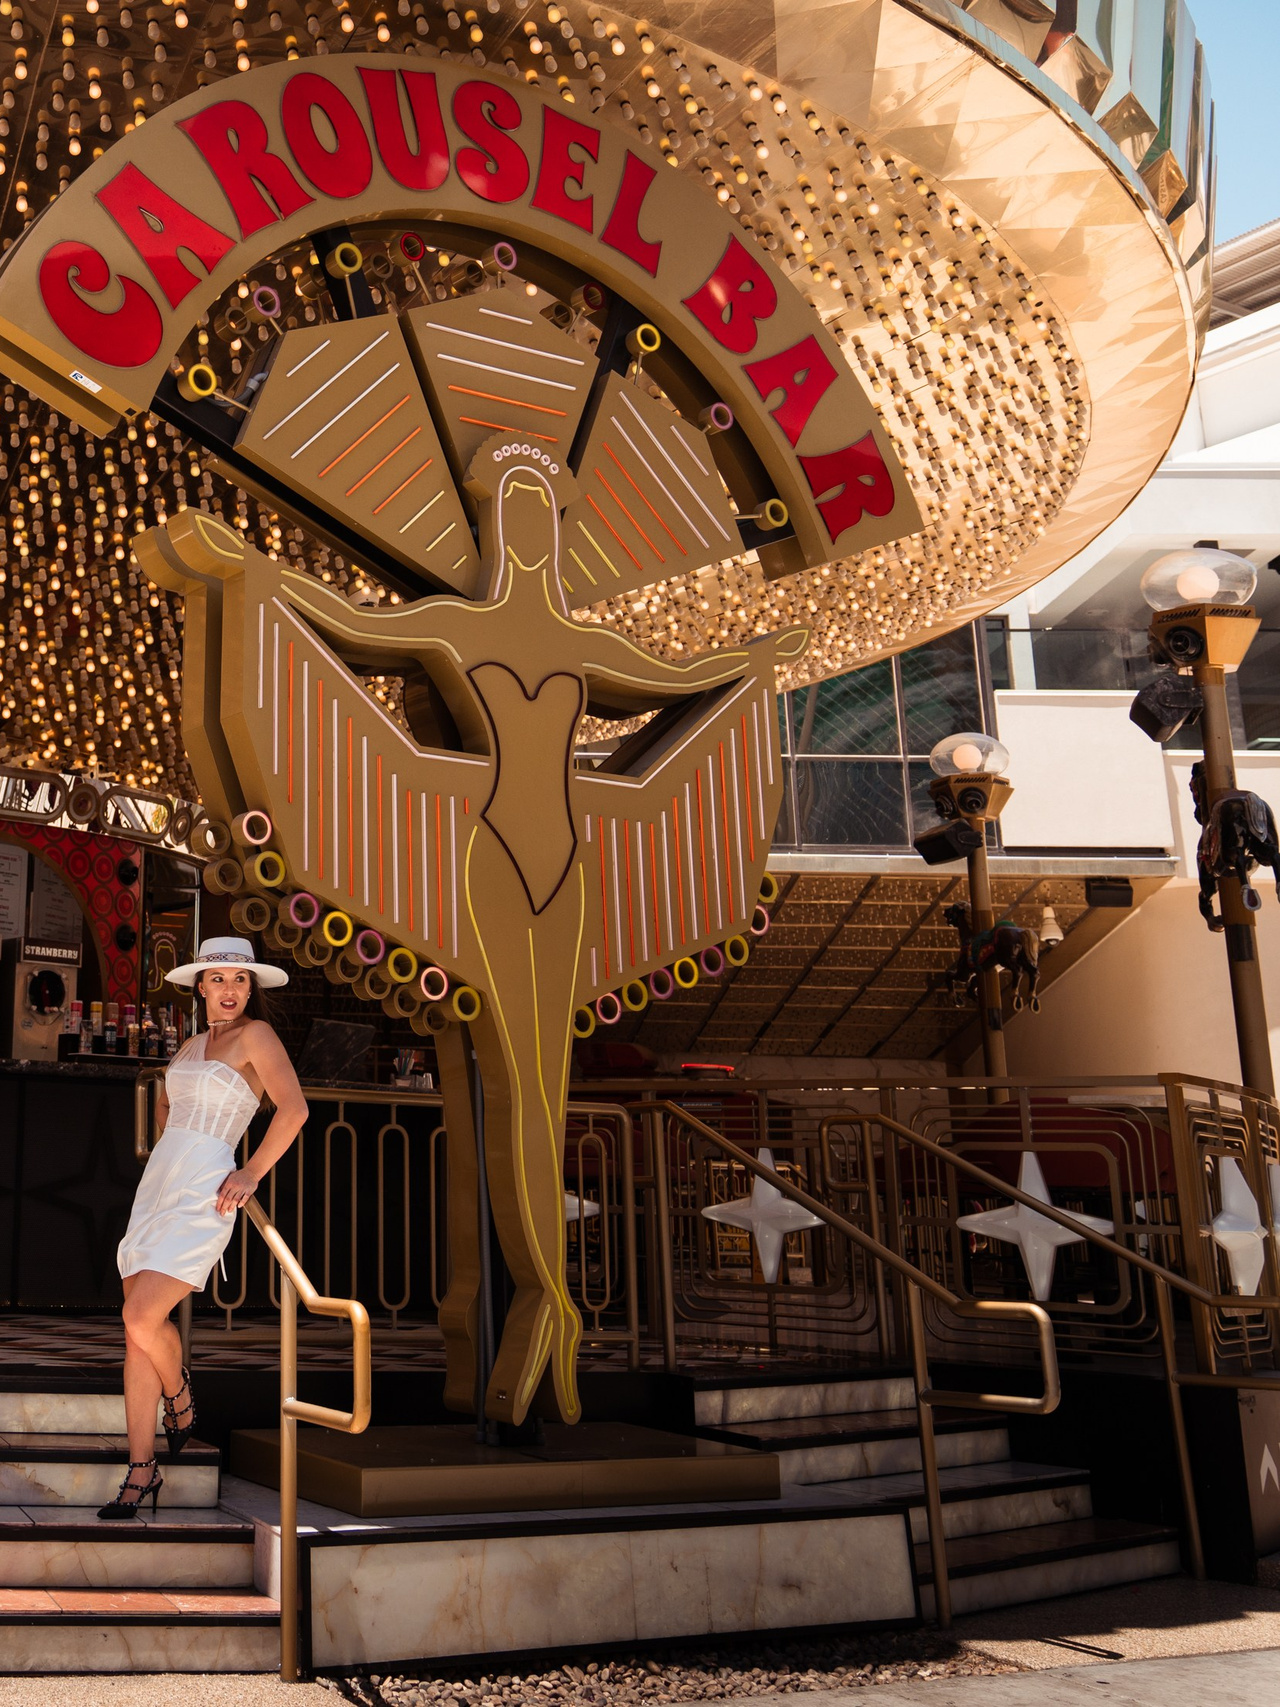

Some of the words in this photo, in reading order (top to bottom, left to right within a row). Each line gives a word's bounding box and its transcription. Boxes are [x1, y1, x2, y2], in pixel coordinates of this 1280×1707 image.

[37, 68, 662, 369] CAROUSEL
[682, 234, 895, 542] BAR
[25, 945, 79, 960] STRAWBERRY
